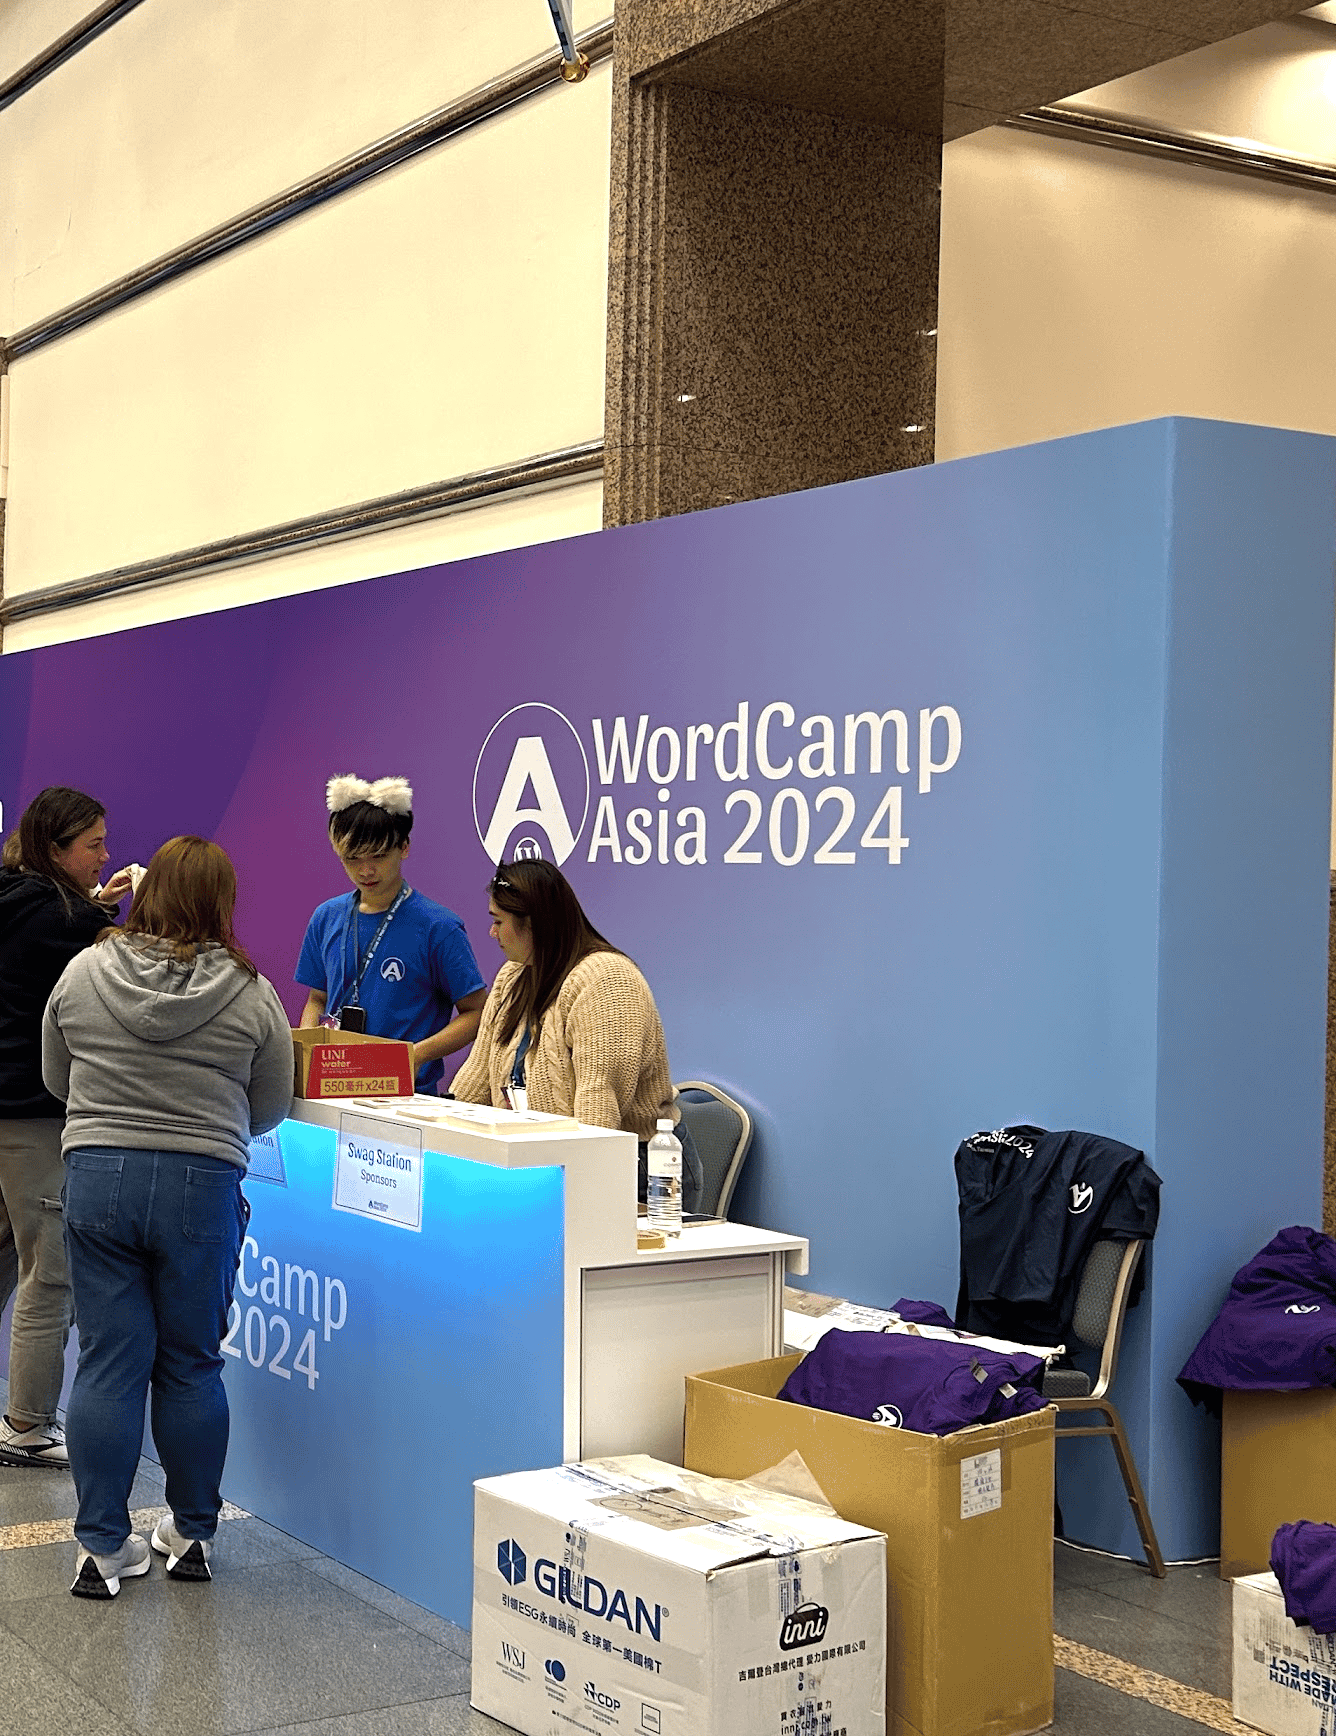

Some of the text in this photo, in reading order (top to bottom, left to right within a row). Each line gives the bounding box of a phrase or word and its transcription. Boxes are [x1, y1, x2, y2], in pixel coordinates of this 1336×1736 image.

[591, 700, 963, 794] WordCamp
[587, 785, 910, 866] Asia 2024
[321, 1060, 351, 1068] water
[348, 1142, 412, 1173] Swag Station
[360, 1168, 398, 1189] Sponsors
[219, 1299, 320, 1391] 2024
[533, 1557, 662, 1643] GILDAN
[783, 1610, 826, 1645] inni
[501, 1640, 526, 1670] WSJ
[1269, 1670, 1302, 1693] WITH
[597, 1692, 621, 1711] CDP
